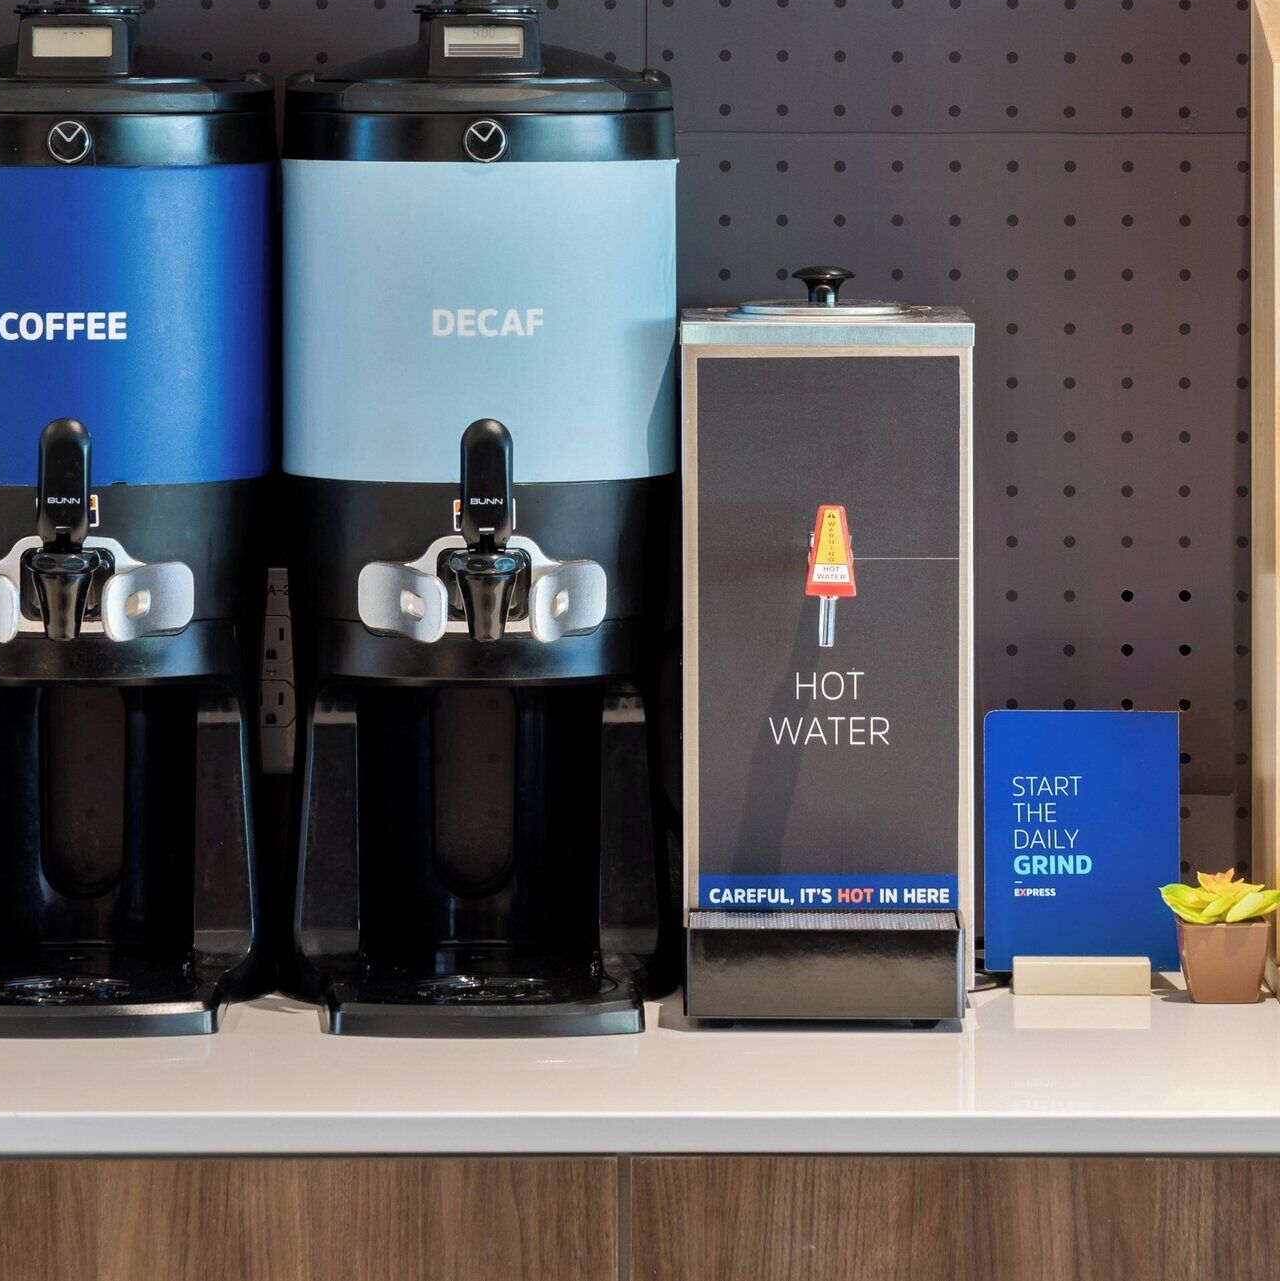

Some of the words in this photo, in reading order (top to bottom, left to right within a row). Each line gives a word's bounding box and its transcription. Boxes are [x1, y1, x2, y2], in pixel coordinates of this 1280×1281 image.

[432, 308, 544, 337] DECAF
[796, 672, 865, 700] HOT
[769, 716, 890, 745] WATER
[1012, 776, 1082, 797] START
[1012, 802, 1057, 823] THE
[1014, 829, 1079, 849] DAILY
[1013, 854, 1093, 875] GRIND
[709, 888, 795, 906] CAREFUL,
[800, 888, 832, 904] IT'S
[837, 888, 874, 904] HOT
[879, 888, 898, 904] IN
[903, 888, 950, 904] HERE
[1014, 888, 1057, 897] EXPRESS
